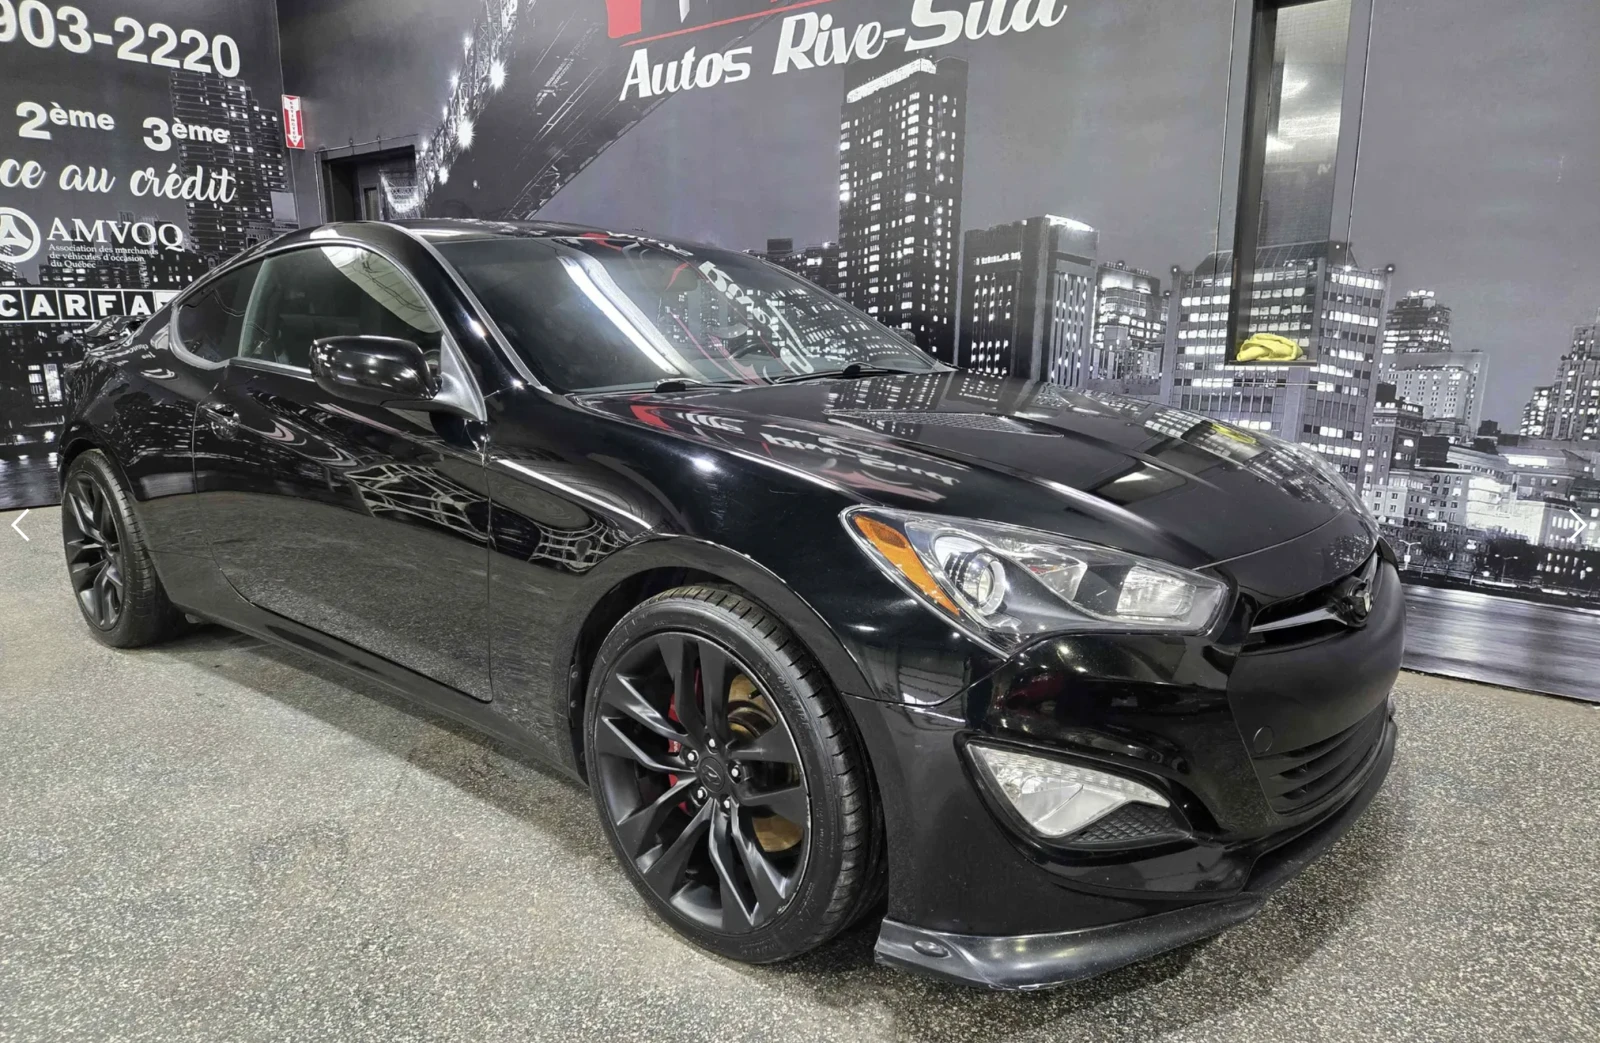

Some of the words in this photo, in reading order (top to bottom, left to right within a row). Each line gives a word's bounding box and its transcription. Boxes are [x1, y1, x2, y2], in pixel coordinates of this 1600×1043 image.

[619, 46, 752, 101] Autos
[16, 101, 115, 140] 2ème
[142, 117, 230, 152] 3ème
[59, 164, 116, 193] au
[130, 163, 237, 203] crédit
[46, 217, 186, 252] AMVOQ
[48, 243, 97, 253] Association
[98, 245, 113, 253] des
[114, 246, 159, 255] marchands
[62, 252, 101, 261] véhicules
[103, 254, 145, 262] d'occasion
[64, 260, 96, 269] Québec
